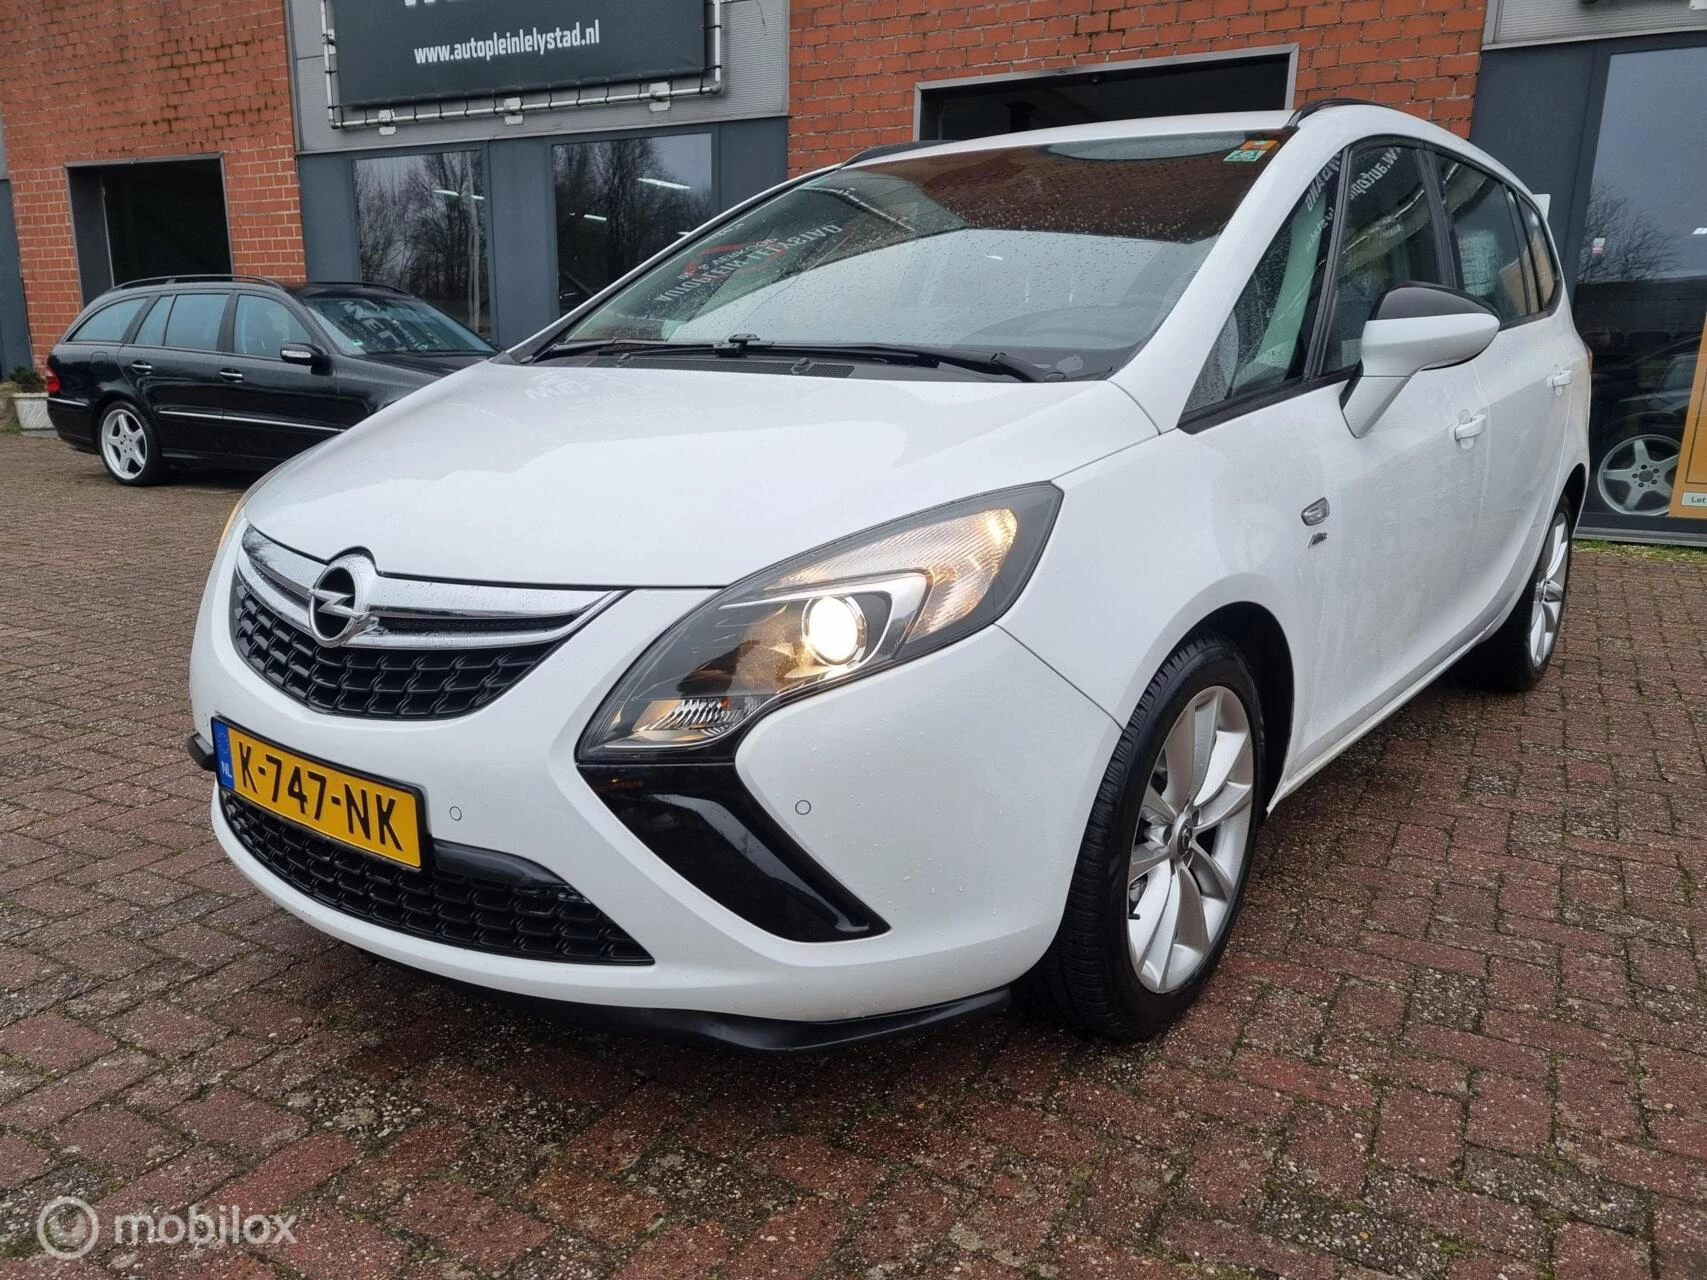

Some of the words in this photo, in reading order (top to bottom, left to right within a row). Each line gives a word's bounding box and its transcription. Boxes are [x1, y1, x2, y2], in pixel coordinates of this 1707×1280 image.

[413, 19, 601, 65] www.autopleinlelystad.nl
[221, 760, 233, 778] NL
[238, 741, 403, 851] K-747-NK
